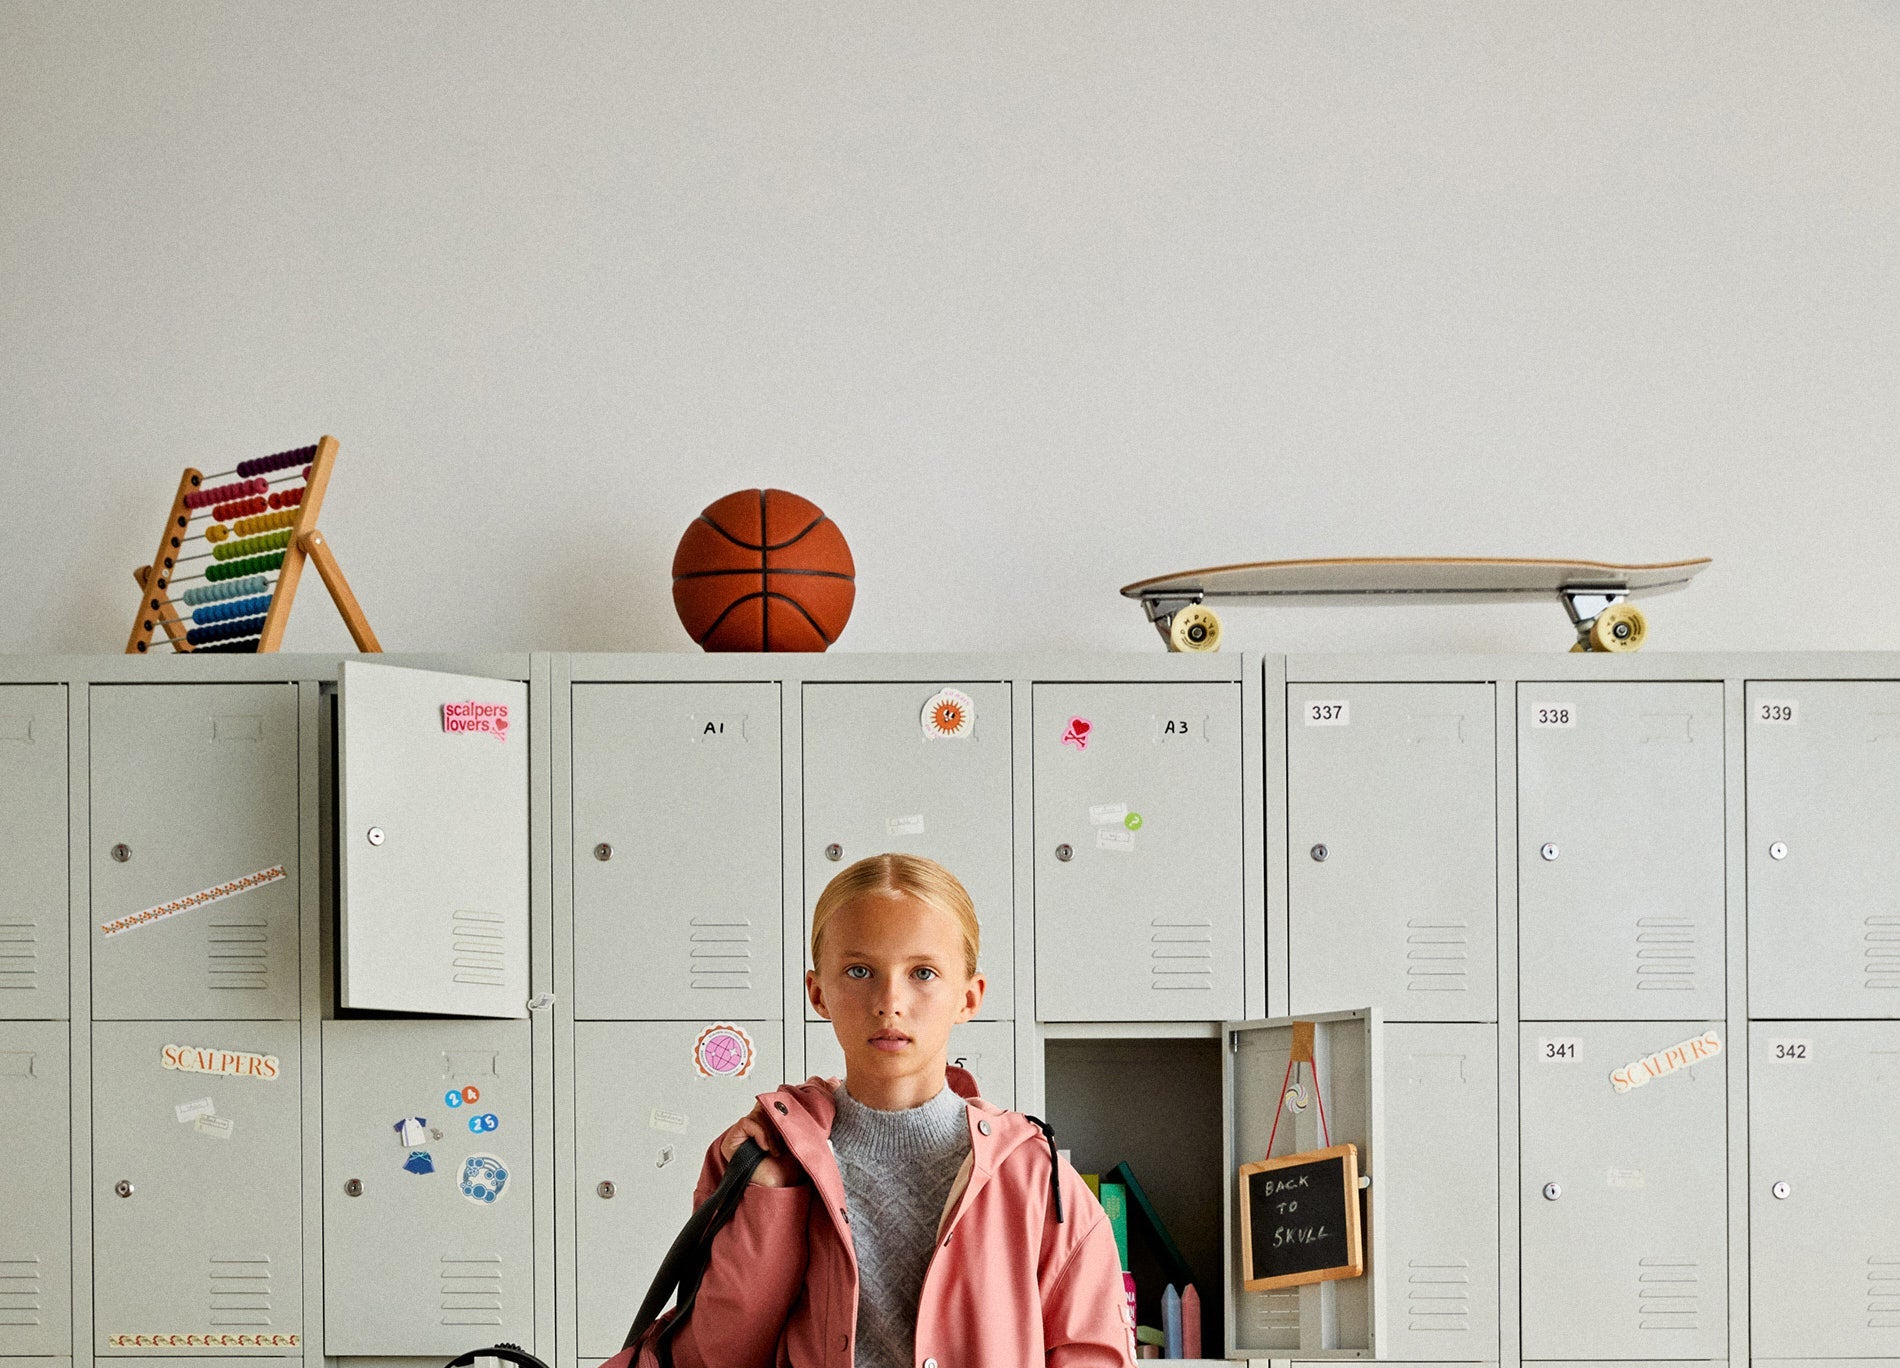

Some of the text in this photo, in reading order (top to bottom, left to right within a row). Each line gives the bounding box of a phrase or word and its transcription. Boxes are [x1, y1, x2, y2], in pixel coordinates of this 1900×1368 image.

[446, 702, 508, 720] scalpers
[1312, 706, 1342, 720] 337
[1539, 709, 1569, 724] 338
[1762, 705, 1792, 720] 339
[446, 717, 490, 731] lovers
[1546, 1043, 1574, 1058] 341
[1776, 1044, 1806, 1059] 342
[164, 1046, 277, 1077] SCALPERS
[1612, 1034, 1720, 1090] SCALPERS
[1264, 1175, 1310, 1197] BACK
[1275, 1200, 1298, 1215] TO
